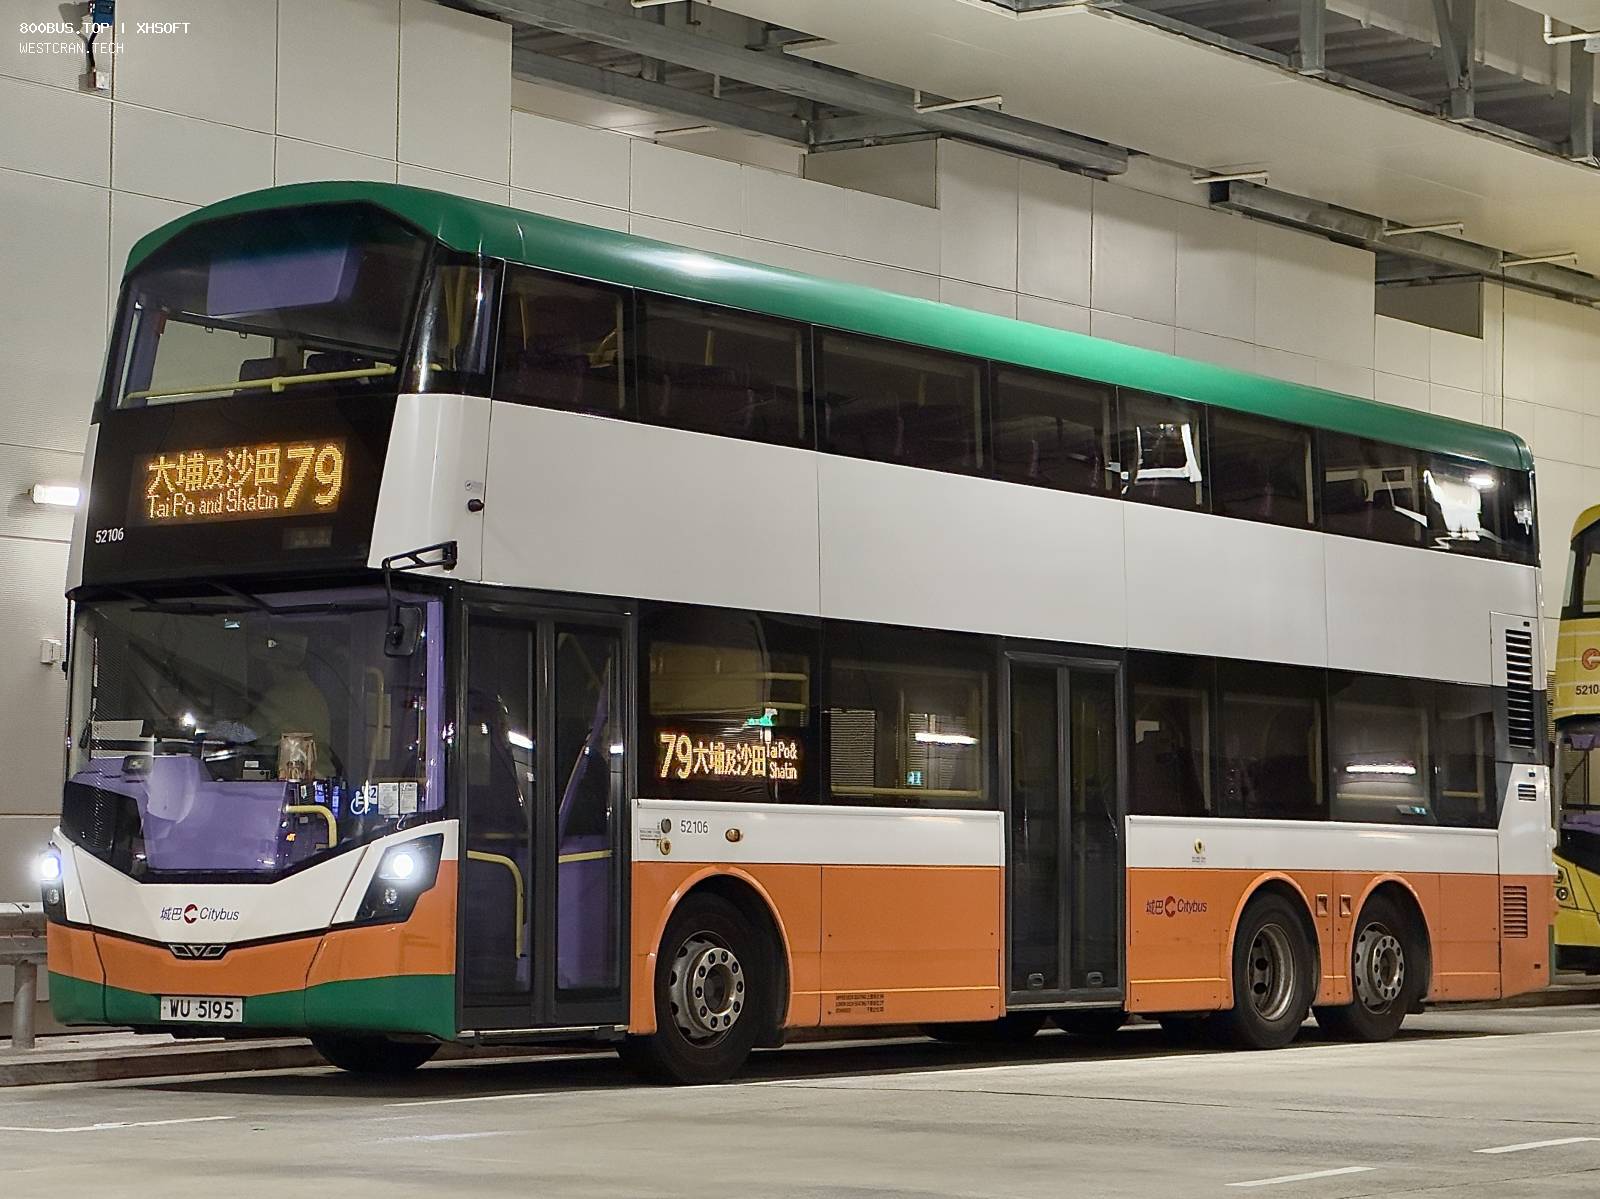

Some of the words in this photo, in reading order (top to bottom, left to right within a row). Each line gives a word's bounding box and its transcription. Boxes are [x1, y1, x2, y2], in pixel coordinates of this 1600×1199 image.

[147, 448, 280, 494] 大埔及沙田
[283, 445, 343, 508] 79
[199, 495, 223, 514] and
[226, 488, 278, 512] Shatin
[95, 527, 124, 543] 52106
[1576, 684, 1600, 696] 5210
[660, 734, 692, 779] 79
[693, 741, 766, 777] 大埔及沙田
[769, 761, 798, 780] Shatin
[680, 820, 709, 834] 52106
[160, 907, 182, 921] 城巴
[199, 907, 240, 921] Citybus
[1177, 898, 1208, 914] Citybus
[169, 999, 191, 1017] WU
[197, 1001, 234, 1019] 5195
